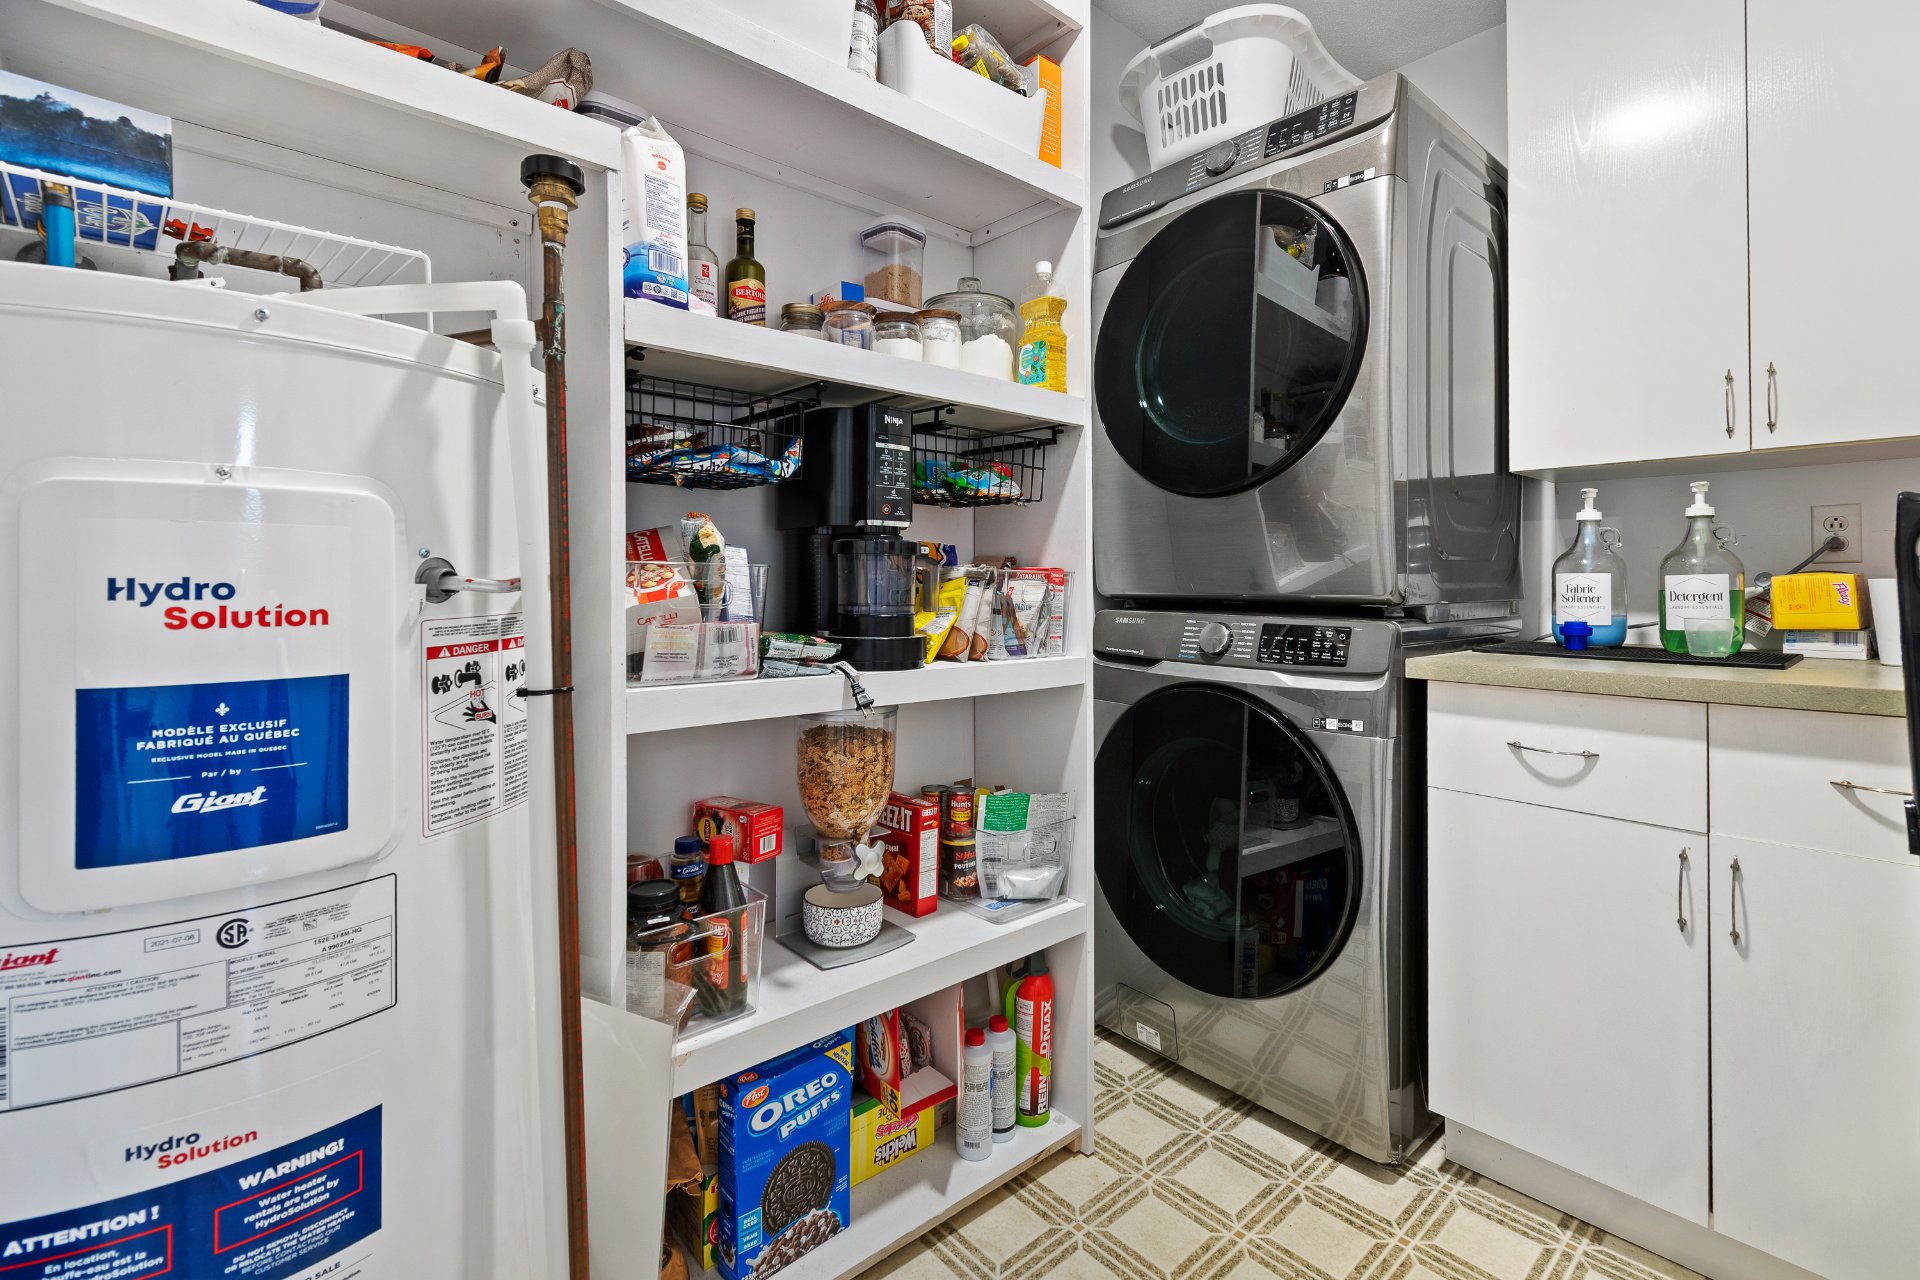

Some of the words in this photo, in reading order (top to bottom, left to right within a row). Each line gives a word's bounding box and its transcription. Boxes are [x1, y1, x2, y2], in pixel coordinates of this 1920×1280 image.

[107, 576, 236, 607] Hydro
[1561, 593, 1603, 604] Softener
[1566, 583, 1596, 594] Fabric
[1669, 590, 1724, 604] Detergent
[164, 603, 329, 630] Solution
[453, 643, 490, 655] DANGER
[469, 688, 486, 698] HOT
[136, 735, 214, 751] FABRIQUÉ
[219, 733, 239, 744] AU
[244, 728, 300, 742] QUÉBEC
[152, 725, 214, 738] MODÈLE
[219, 719, 287, 733] EXCLUSIF
[151, 754, 194, 763] EXCLUSIVE
[229, 768, 241, 776] by
[171, 785, 269, 814] Giant
[44, 969, 122, 985] www.giantinc.com
[840, 1047, 849, 1056] NEW
[745, 1086, 766, 1106] Post
[751, 1071, 837, 1132] OREO
[888, 1089, 899, 1114] 40
[780, 1090, 841, 1139] PUFFS
[125, 1132, 200, 1163] Hydro
[158, 1130, 258, 1169] Solution
[238, 1138, 345, 1190] WARNING!
[243, 1201, 282, 1224] rentals
[284, 1196, 300, 1208] are
[303, 1186, 324, 1200] own
[327, 1178, 339, 1190] by
[258, 1187, 292, 1208] Water
[294, 1174, 327, 1195] heater
[786, 1179, 813, 1200] OREO
[255, 1192, 330, 1230] HydroSolution
[3, 1209, 147, 1258] ATTENTION
[151, 1205, 160, 1220] !
[224, 1263, 237, 1274] OR
[239, 1244, 282, 1270] RELOCATE
[283, 1239, 298, 1251] THE
[299, 1223, 326, 1242] WATER
[327, 1210, 355, 1231] HEATER
[233, 1254, 245, 1264] DO
[247, 1247, 264, 1259] NOT
[302, 1207, 349, 1235] DISCONNECT
[112, 1255, 132, 1267] est
[134, 1251, 147, 1261] la
[241, 1256, 273, 1275] BEFORE
[275, 1231, 325, 1262] CONTACTING
[326, 1224, 341, 1236] OUR
[254, 1252, 298, 1276] CUSTOMER
[299, 1238, 330, 1257] SERVICE
[44, 1264, 61, 1275] En
[64, 1250, 120, 1270] location,
[314, 1261, 342, 1279] SALE
